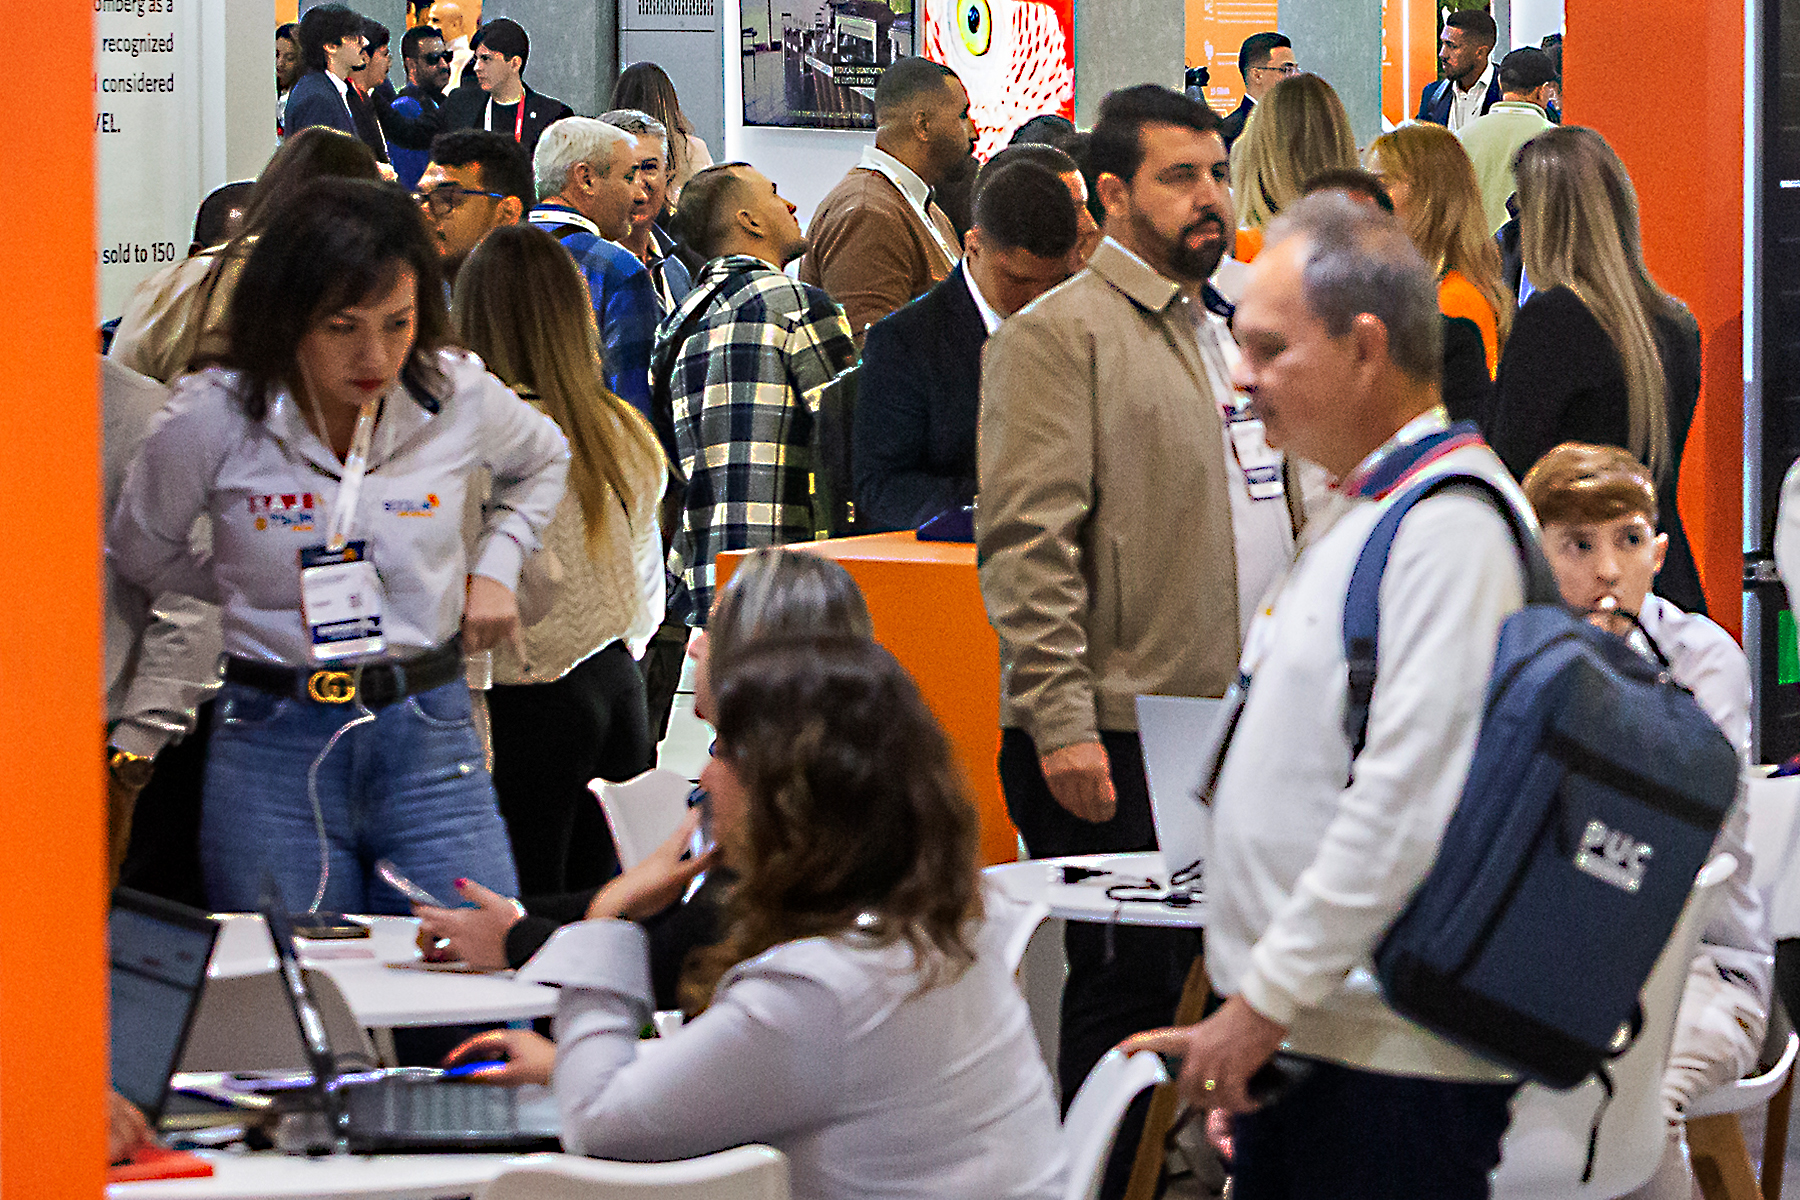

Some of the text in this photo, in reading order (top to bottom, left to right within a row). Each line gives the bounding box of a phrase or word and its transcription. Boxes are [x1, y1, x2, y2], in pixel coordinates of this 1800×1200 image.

[102, 32, 174, 58] recognized
[102, 72, 174, 93] considered
[102, 241, 175, 264] sold to 150
